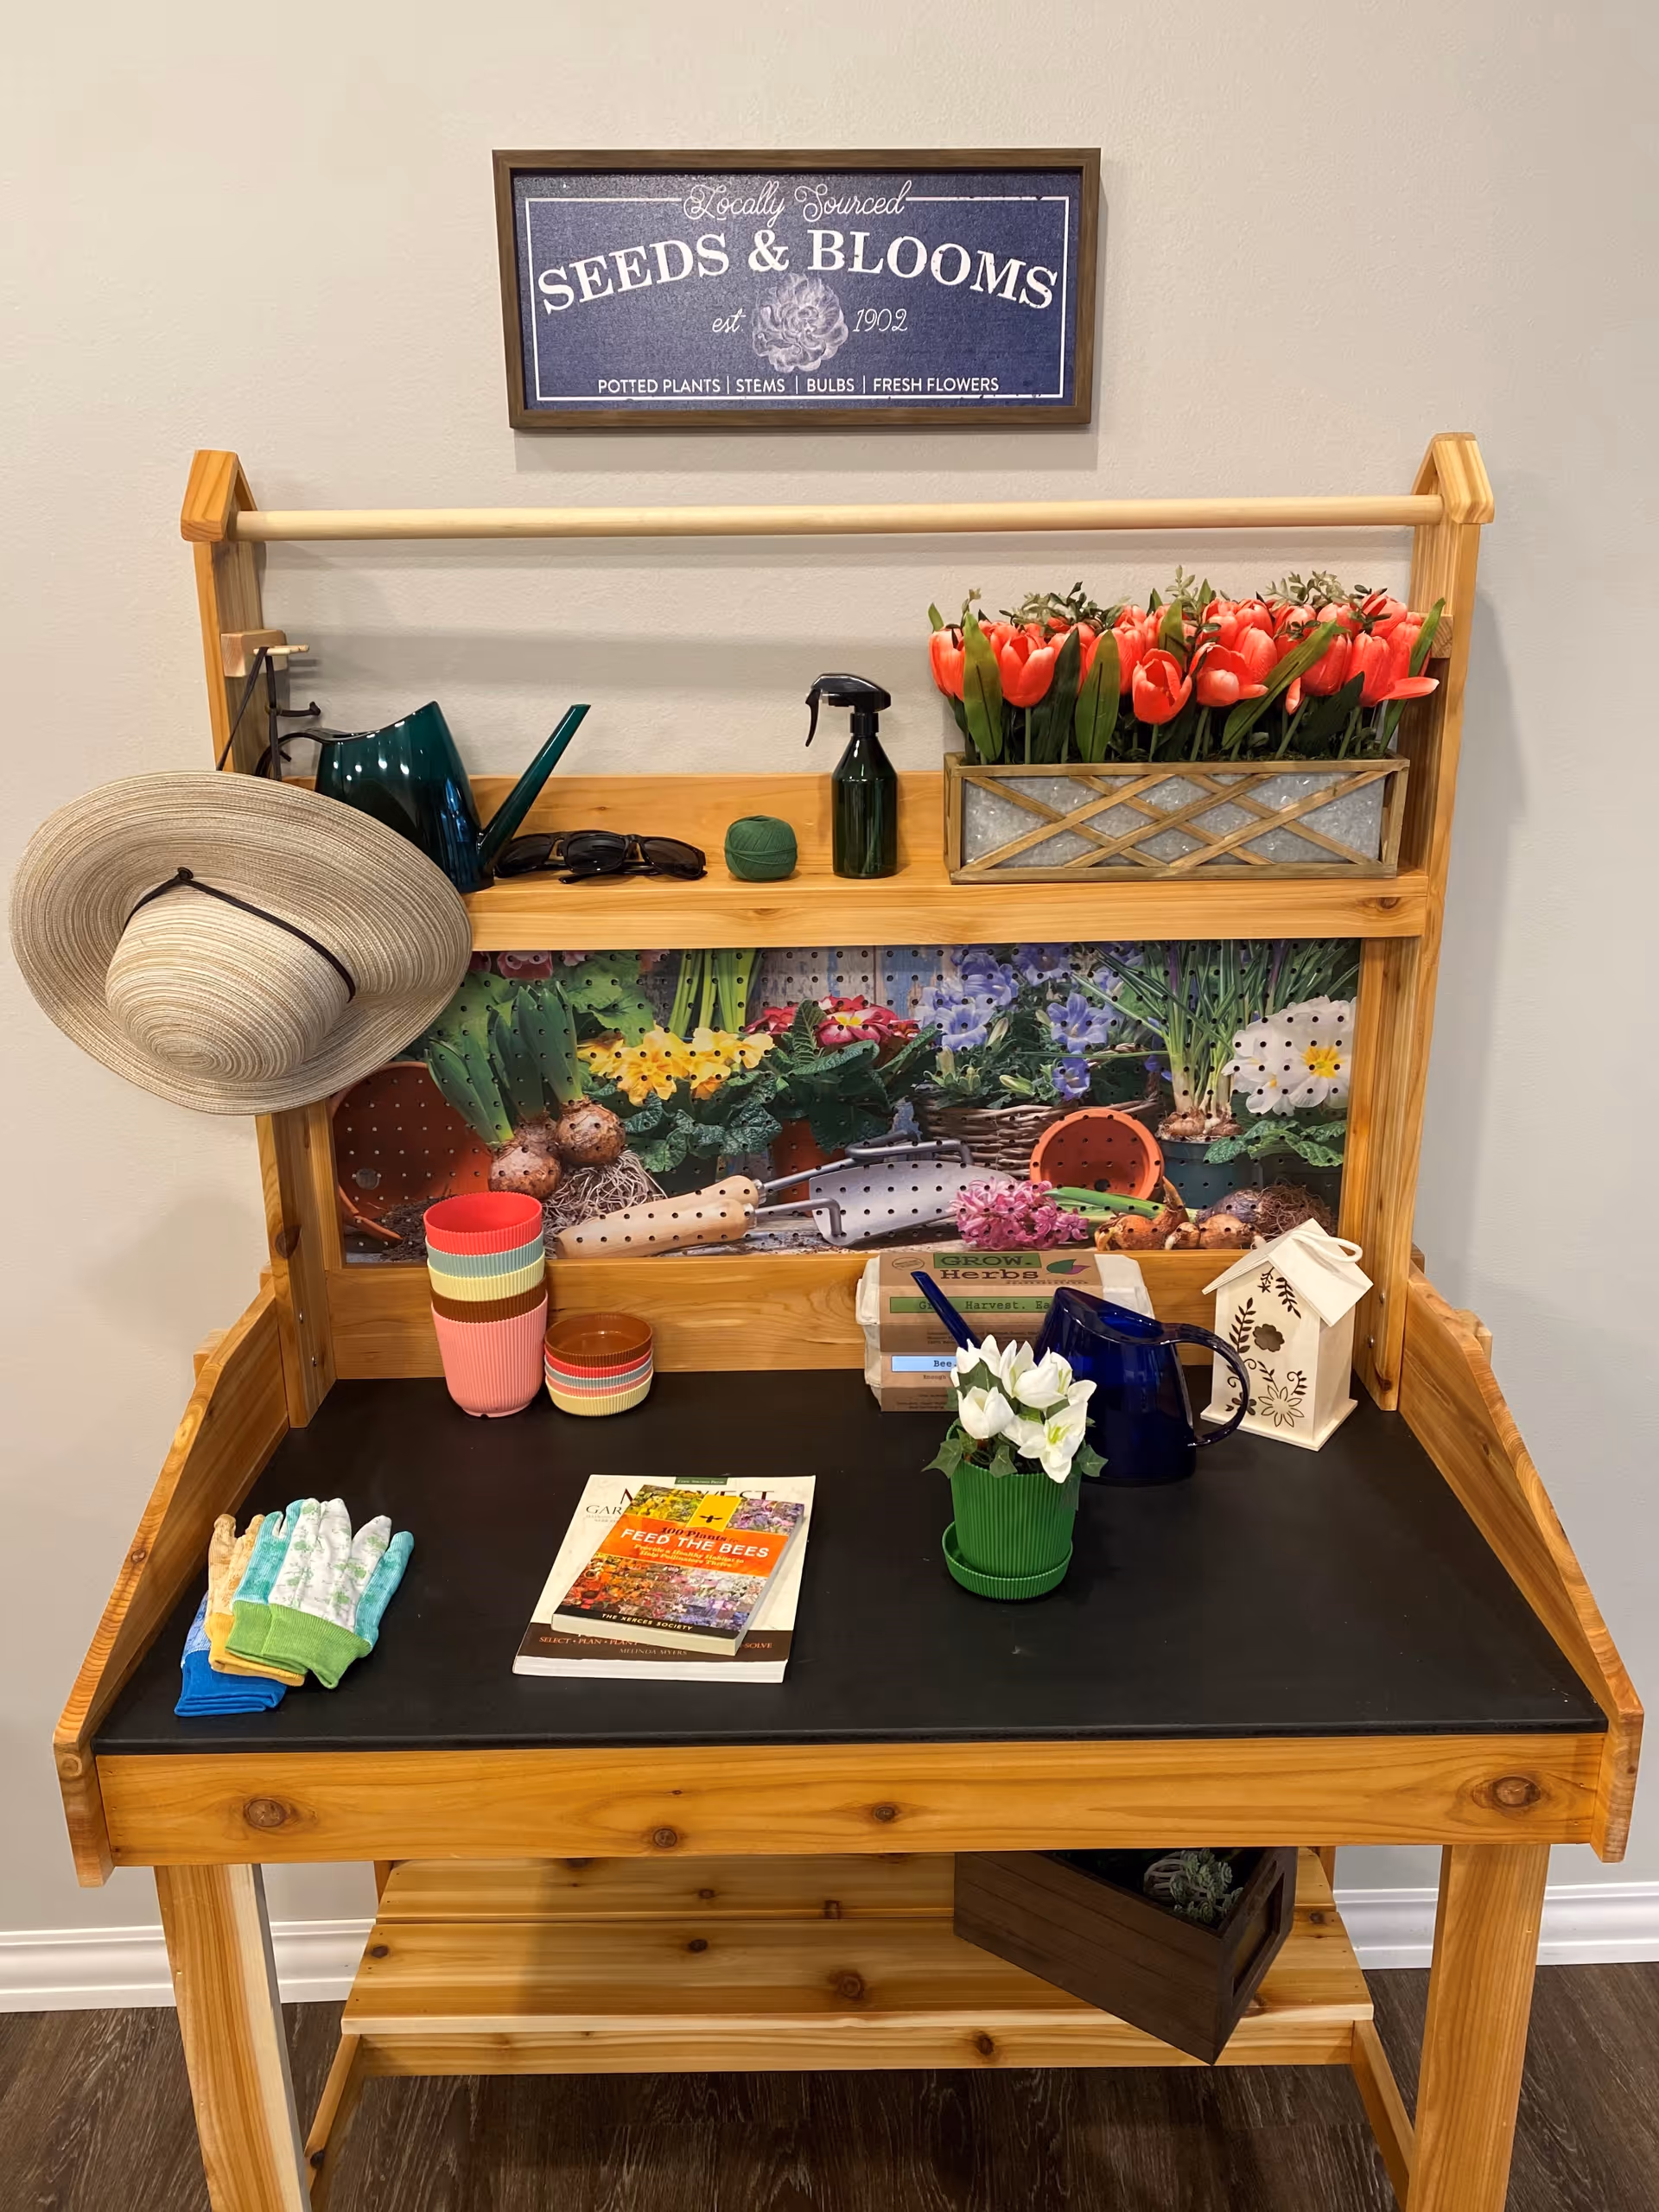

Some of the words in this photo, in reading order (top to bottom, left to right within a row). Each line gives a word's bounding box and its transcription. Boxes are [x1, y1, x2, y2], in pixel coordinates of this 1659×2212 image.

[683, 181, 785, 227] Locally
[794, 180, 912, 222] Sourced
[537, 233, 729, 315] SEEDS
[748, 229, 790, 272] &
[807, 229, 1058, 308] BLOOMS
[852, 308, 907, 332] 1902
[598, 379, 658, 393] POTTED
[663, 378, 721, 393] PLANTS
[736, 378, 785, 392] STEMS
[807, 378, 855, 392] BULBS
[874, 378, 922, 392] FRESH
[927, 378, 999, 392] FLOWERS
[941, 1256, 1033, 1266] GROW.
[940, 1269, 1039, 1279] Herbs
[965, 1300, 1026, 1310] Harvest.
[661, 1526, 684, 1536] 100
[686, 1530, 727, 1541] Plants
[620, 1529, 670, 1545] FEED
[677, 1537, 714, 1552] THE
[719, 1543, 770, 1558] BEES
[620, 1617, 653, 1625] XERCES
[656, 1621, 693, 1631] SOCIETY
